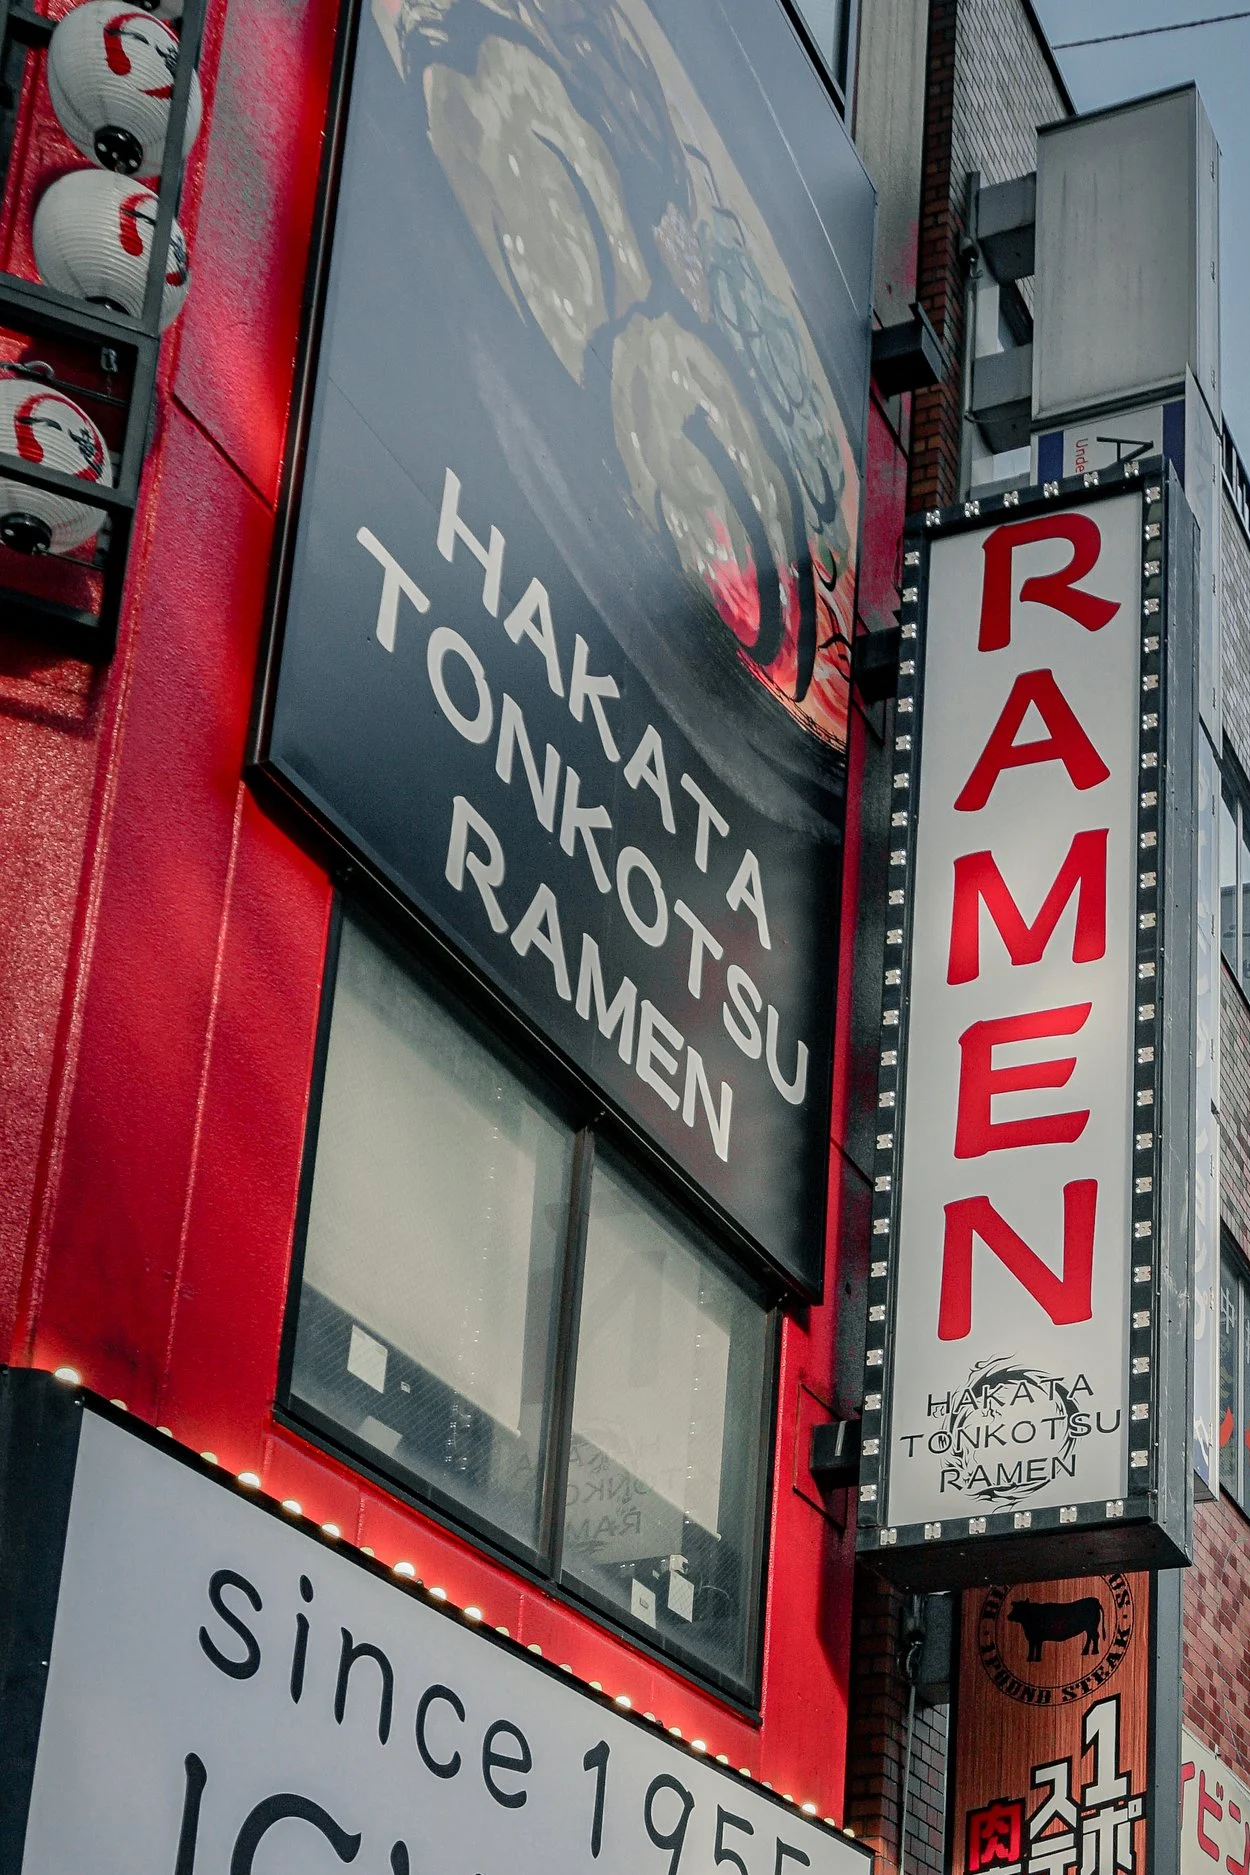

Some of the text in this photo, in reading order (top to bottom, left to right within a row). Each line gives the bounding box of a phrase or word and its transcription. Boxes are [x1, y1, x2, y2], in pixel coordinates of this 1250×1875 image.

[355, 525, 807, 1106] TONKOTSU
[436, 468, 772, 950] HAKATA
[445, 795, 732, 1163] RAMEN
[937, 511, 1122, 1342] RAMEN
[900, 1410, 1122, 1458] TONKOTSU
[927, 1374, 1094, 1418] HAKATA
[939, 1454, 1077, 1494] RAMEN
[199, 1569, 533, 1808] since
